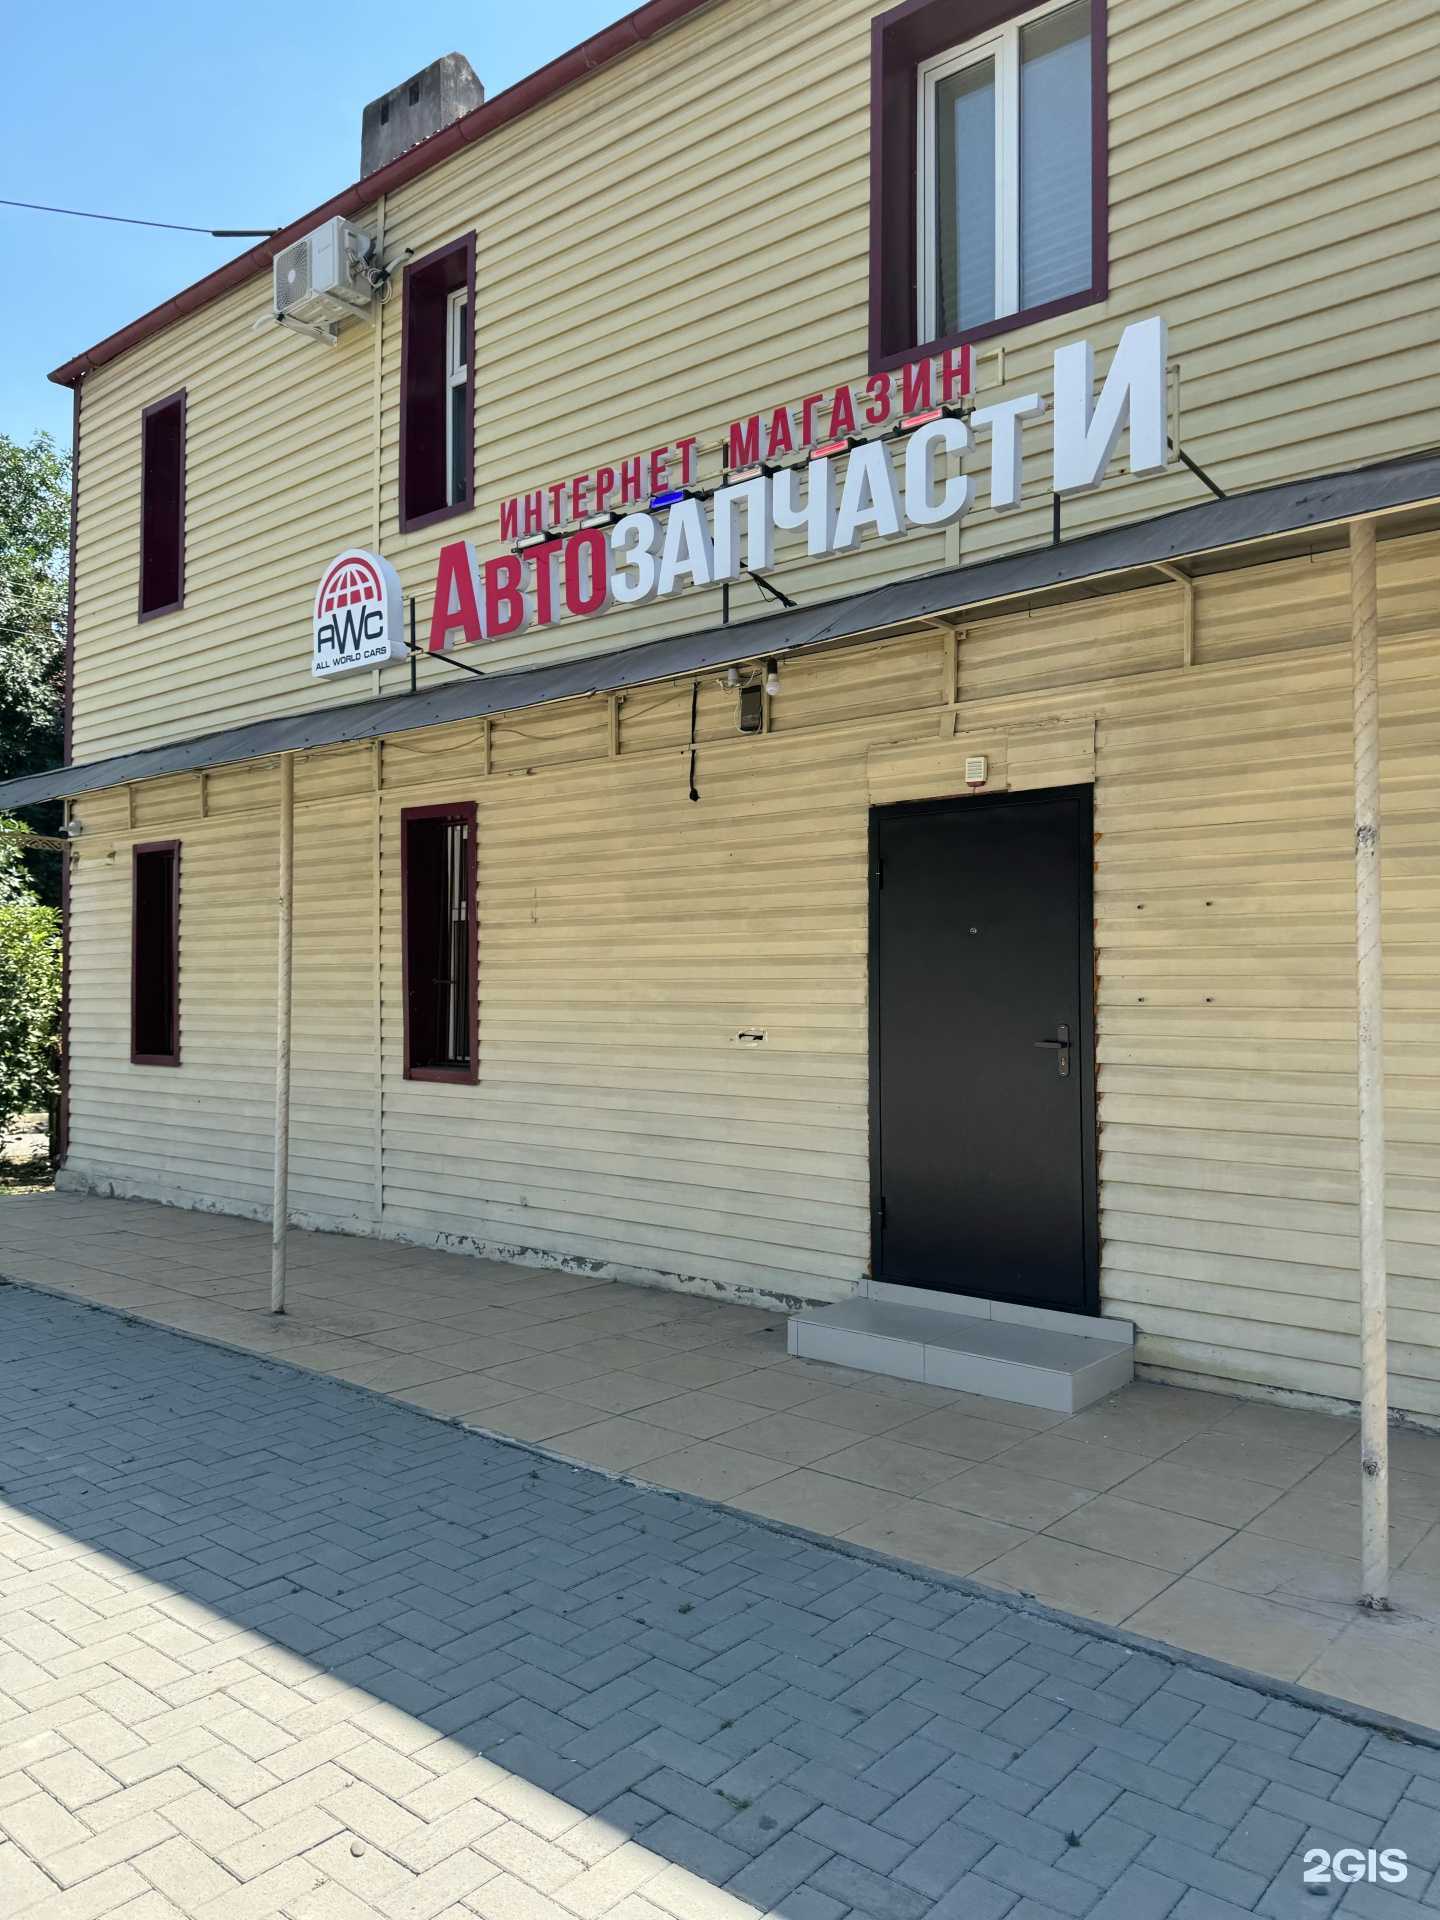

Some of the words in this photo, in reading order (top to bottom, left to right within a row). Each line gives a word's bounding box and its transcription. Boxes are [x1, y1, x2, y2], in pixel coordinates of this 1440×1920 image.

[499, 436, 697, 541] ИНТЕРНЕТ
[728, 343, 975, 467] МАГАЗИН
[317, 605, 383, 654] AWC
[315, 661, 330, 671] ALL
[332, 653, 361, 666] WORLD
[363, 646, 387, 658] CARS
